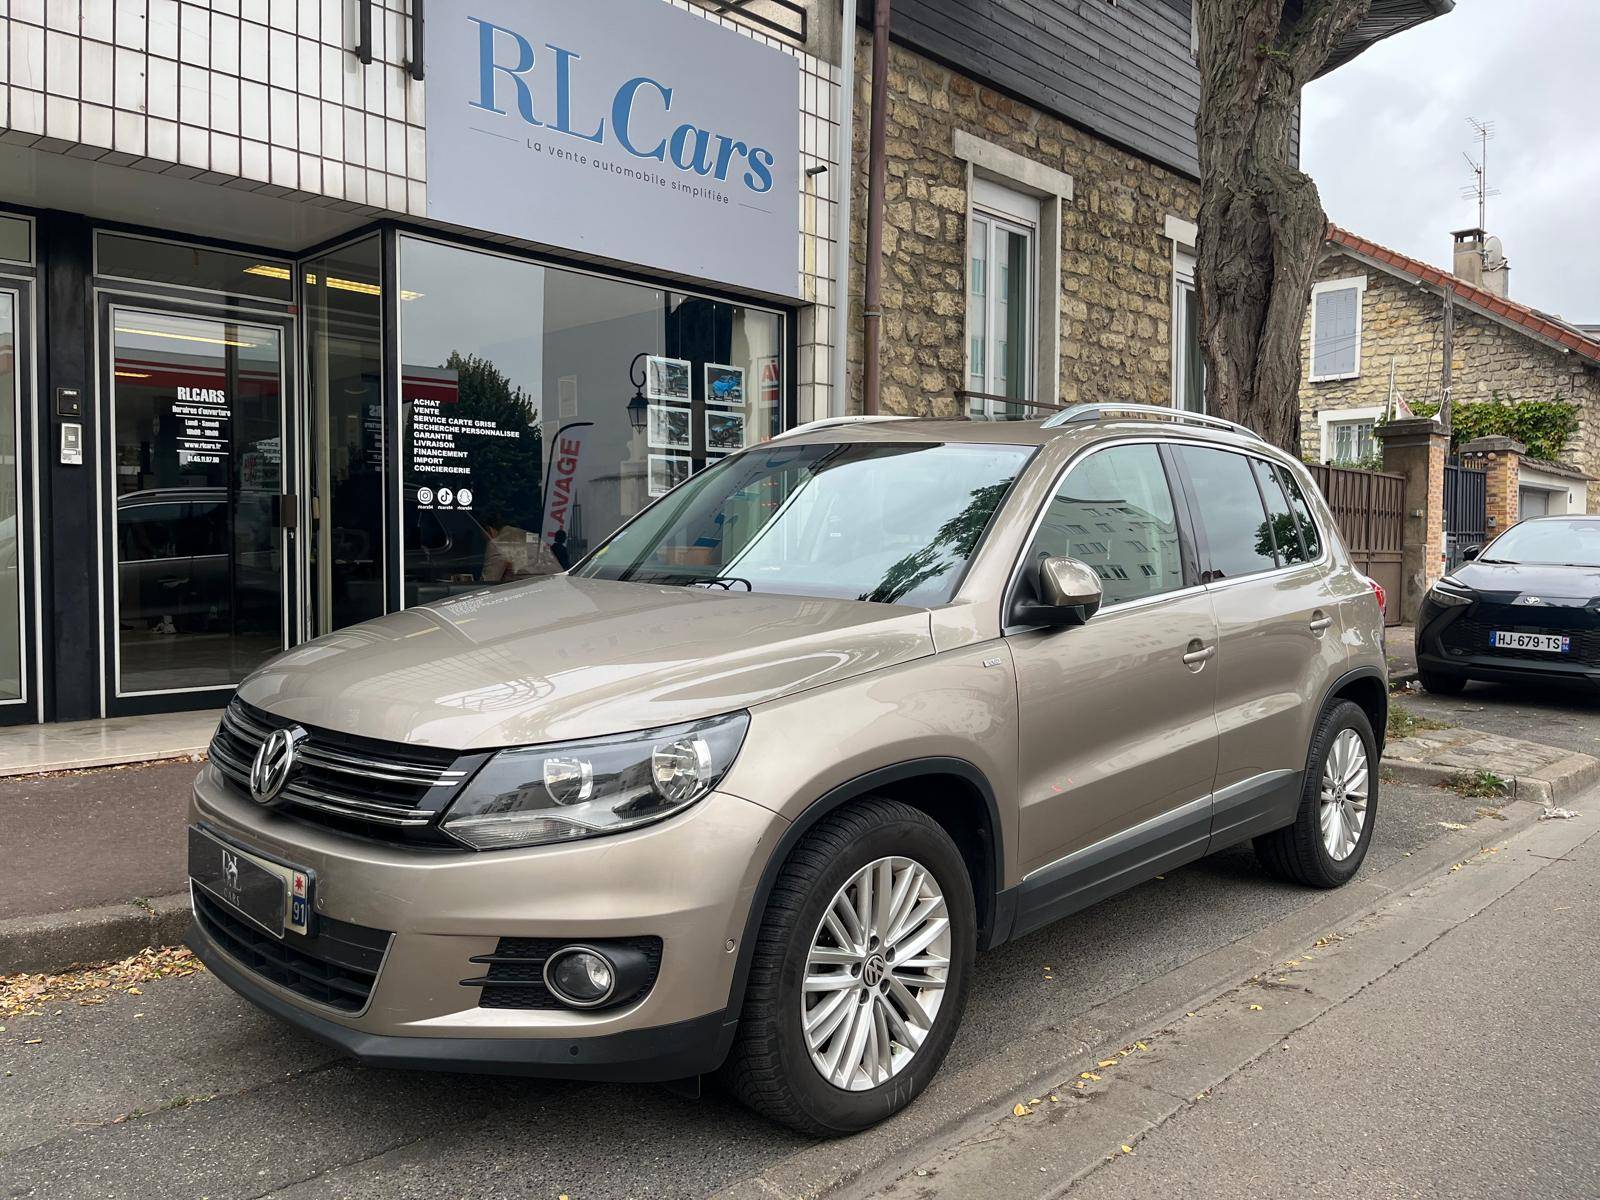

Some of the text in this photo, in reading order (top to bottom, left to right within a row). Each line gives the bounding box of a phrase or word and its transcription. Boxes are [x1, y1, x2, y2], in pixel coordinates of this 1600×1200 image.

[527, 138, 729, 204] La vente automobile simplifiée
[177, 386, 225, 404] RLCARS
[414, 398, 441, 407] ACHAT
[414, 406, 440, 415] VENTE
[414, 415, 497, 428] SERVICE CARTE GRISE
[414, 423, 520, 438] RECHERCHE PERSONNALISEE
[414, 431, 453, 440] GARANTIE
[414, 440, 455, 448] LIVRAISON
[414, 448, 468, 458] FINANCEMENT
[414, 456, 444, 464] IMPORT
[414, 465, 471, 474] CONCIERGERIE
[1498, 634, 1560, 649] HJ-679-TS
[293, 901, 305, 924] 91
